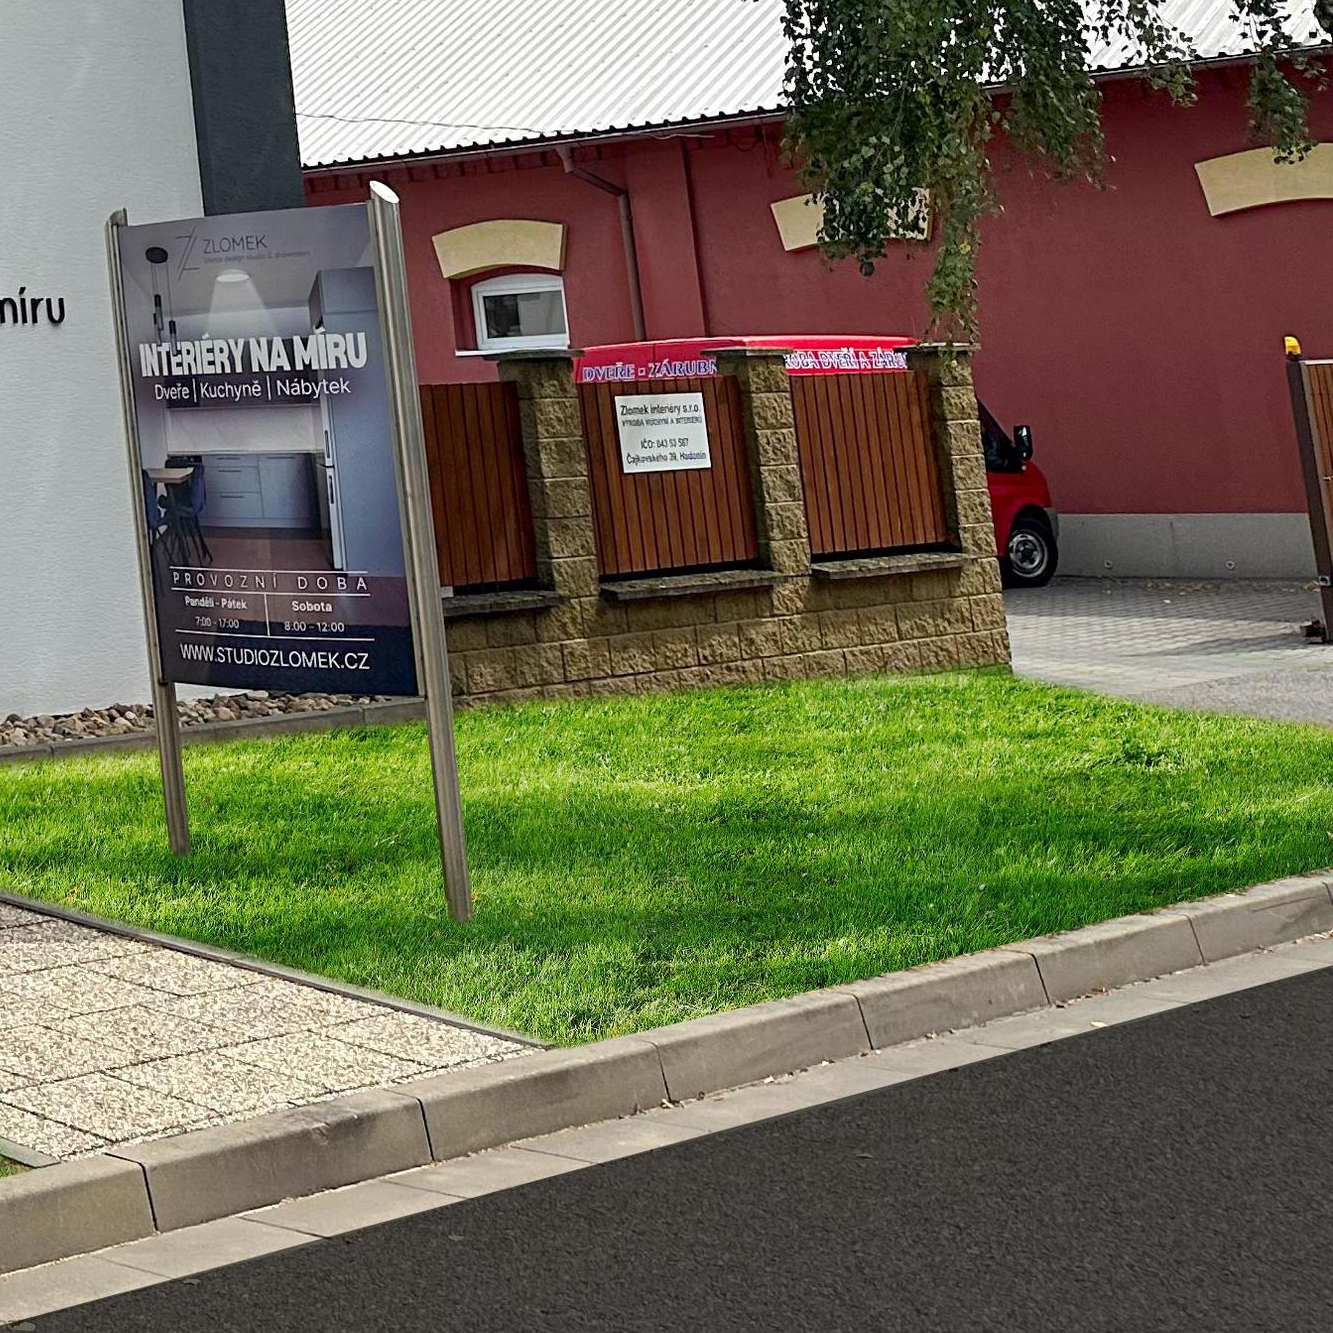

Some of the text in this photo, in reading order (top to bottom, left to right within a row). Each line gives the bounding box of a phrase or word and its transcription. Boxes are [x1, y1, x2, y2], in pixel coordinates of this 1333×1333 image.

[203, 234, 268, 254] ZLOMEK
[139, 326, 368, 377] INTERIÉRY NA MÍRU
[583, 361, 635, 381] DVEŘE
[154, 377, 352, 402] Dveře Kuchyně Nábytek
[173, 571, 367, 590] PROVOZNÍ DOBA
[221, 597, 248, 610] Pátek
[291, 600, 333, 613] Sobota
[218, 617, 240, 629] 17:00
[284, 621, 307, 632] 8:00
[316, 622, 345, 633] 12:00
[180, 643, 370, 670] WWW.STUDIOZLOMEK.CZ
